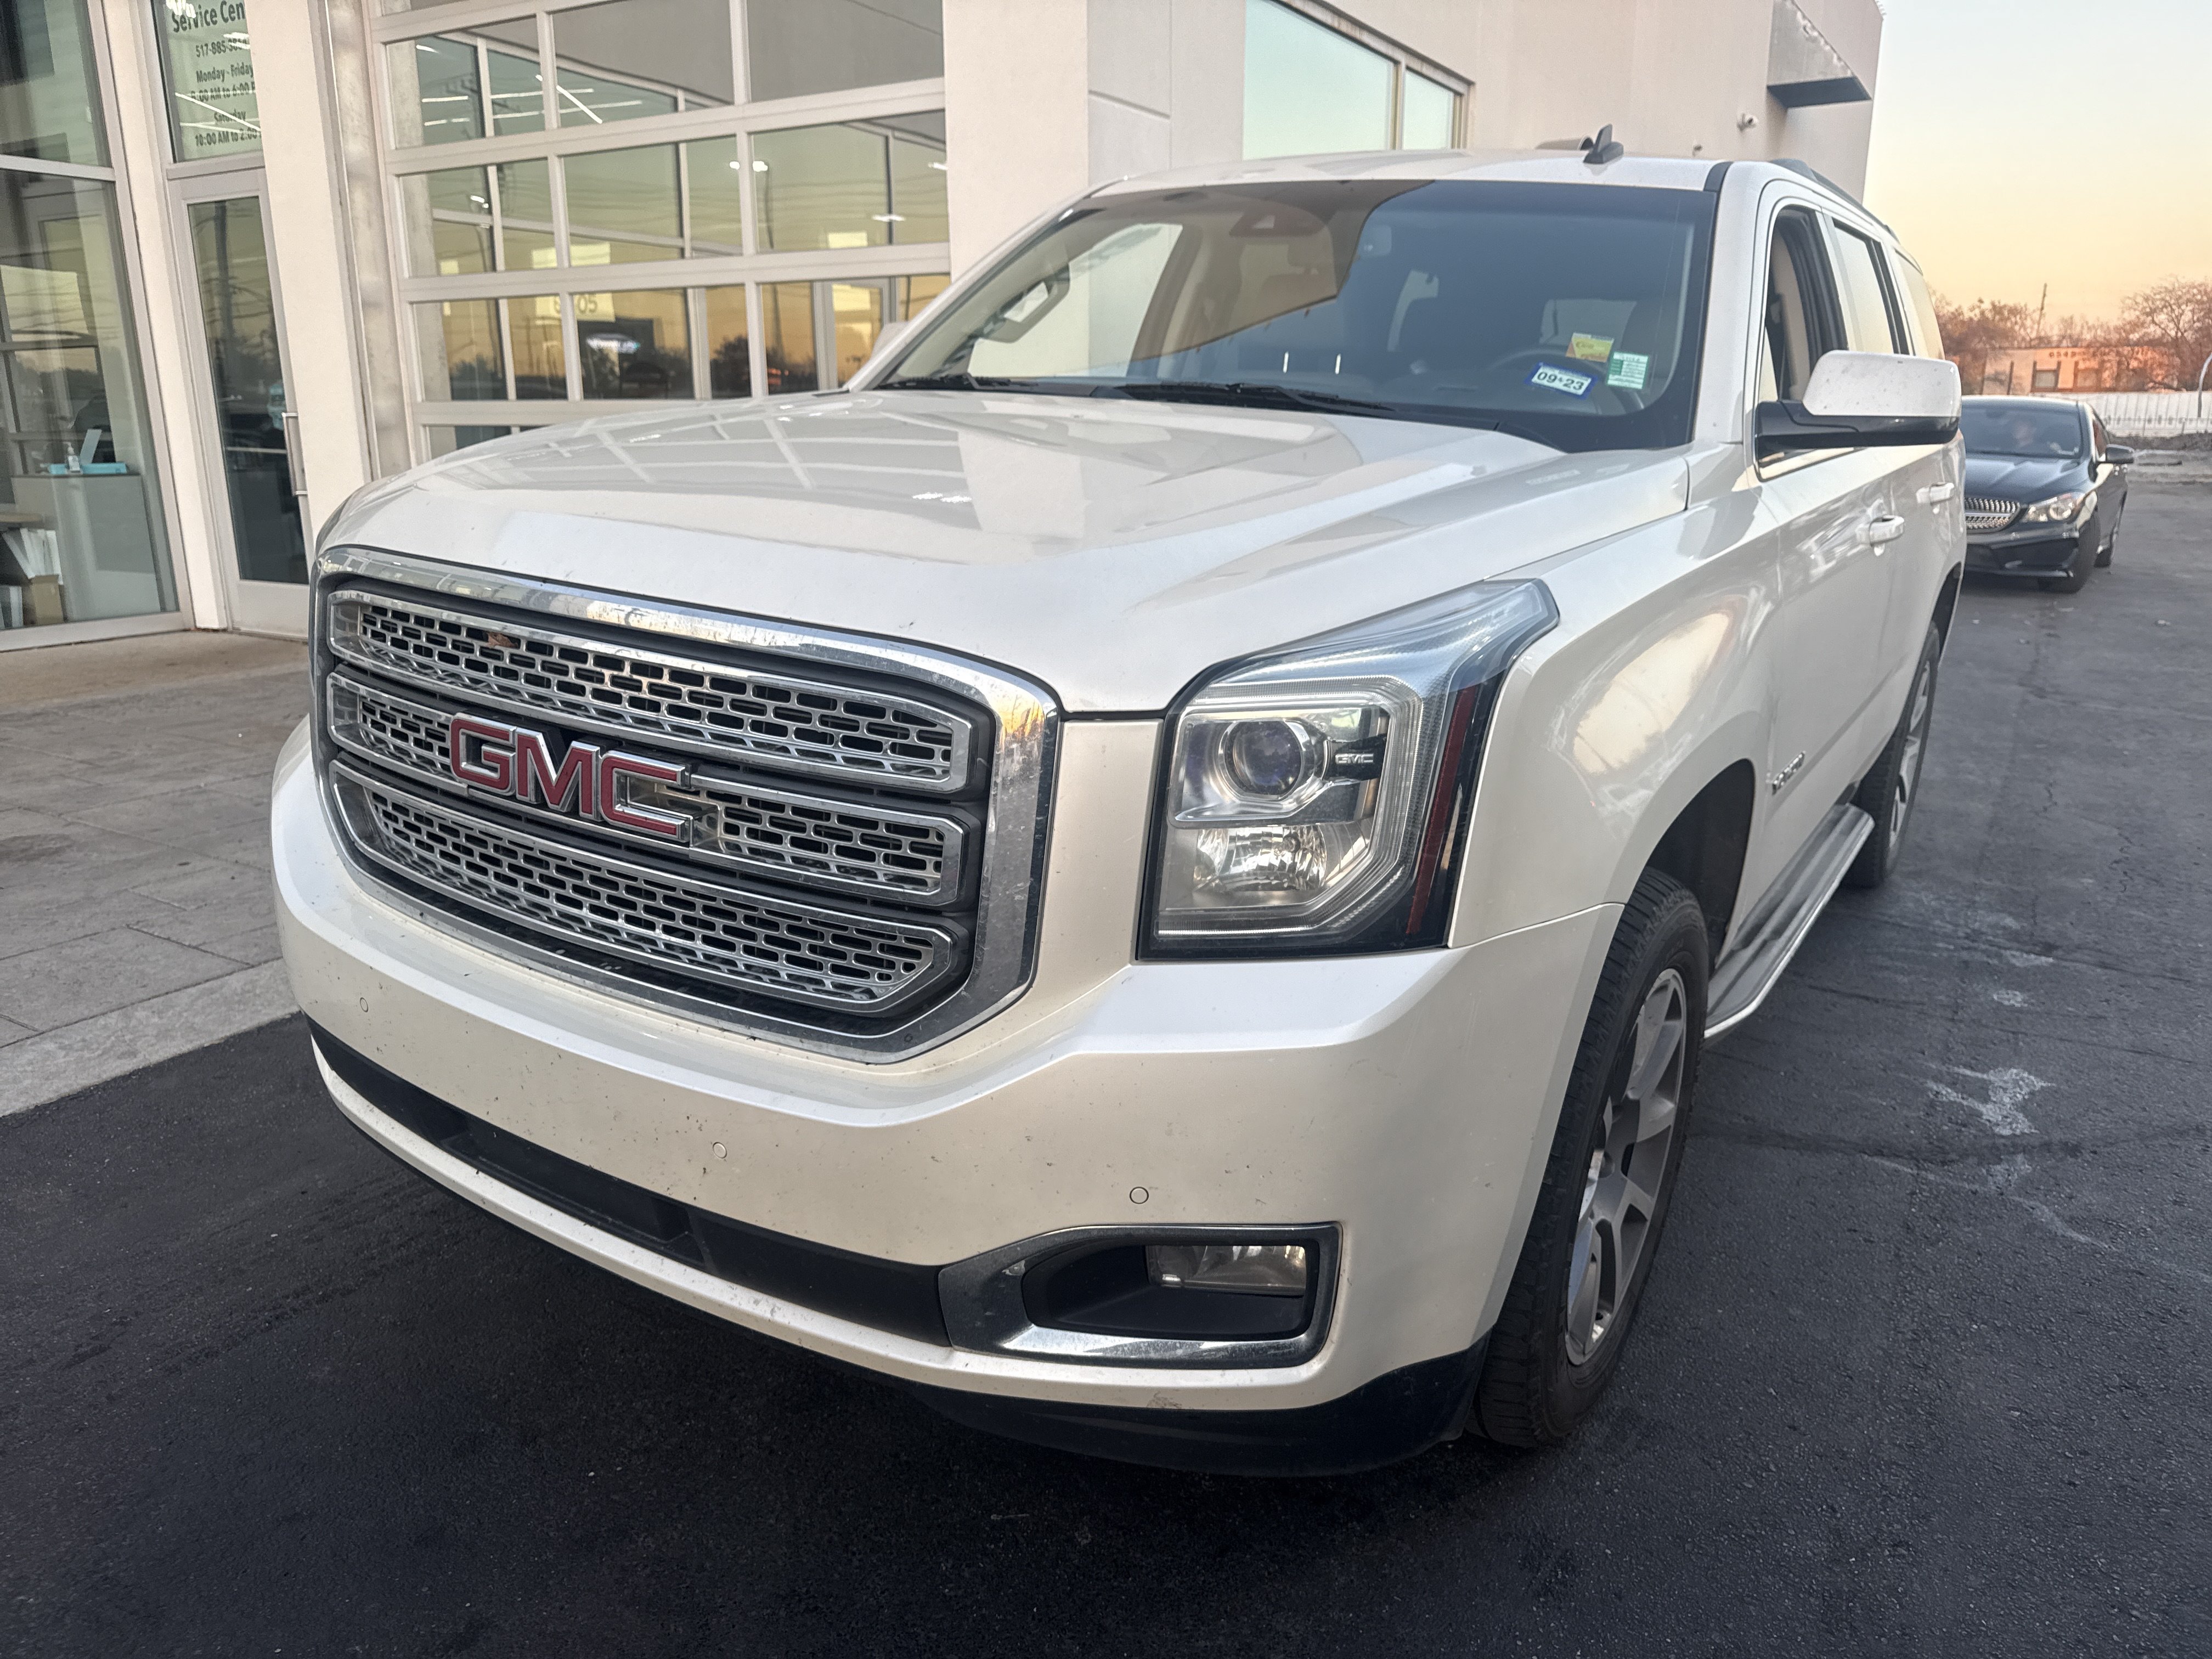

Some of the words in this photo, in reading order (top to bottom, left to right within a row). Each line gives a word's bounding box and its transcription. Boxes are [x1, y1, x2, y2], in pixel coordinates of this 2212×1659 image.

[172, 4, 218, 32] Service
[196, 67, 225, 83] Monday
[230, 61, 254, 78] Friday
[195, 132, 216, 146] 10:00
[218, 131, 229, 144] AM
[1335, 753, 1374, 764] GMC
[450, 713, 689, 842] GMC
